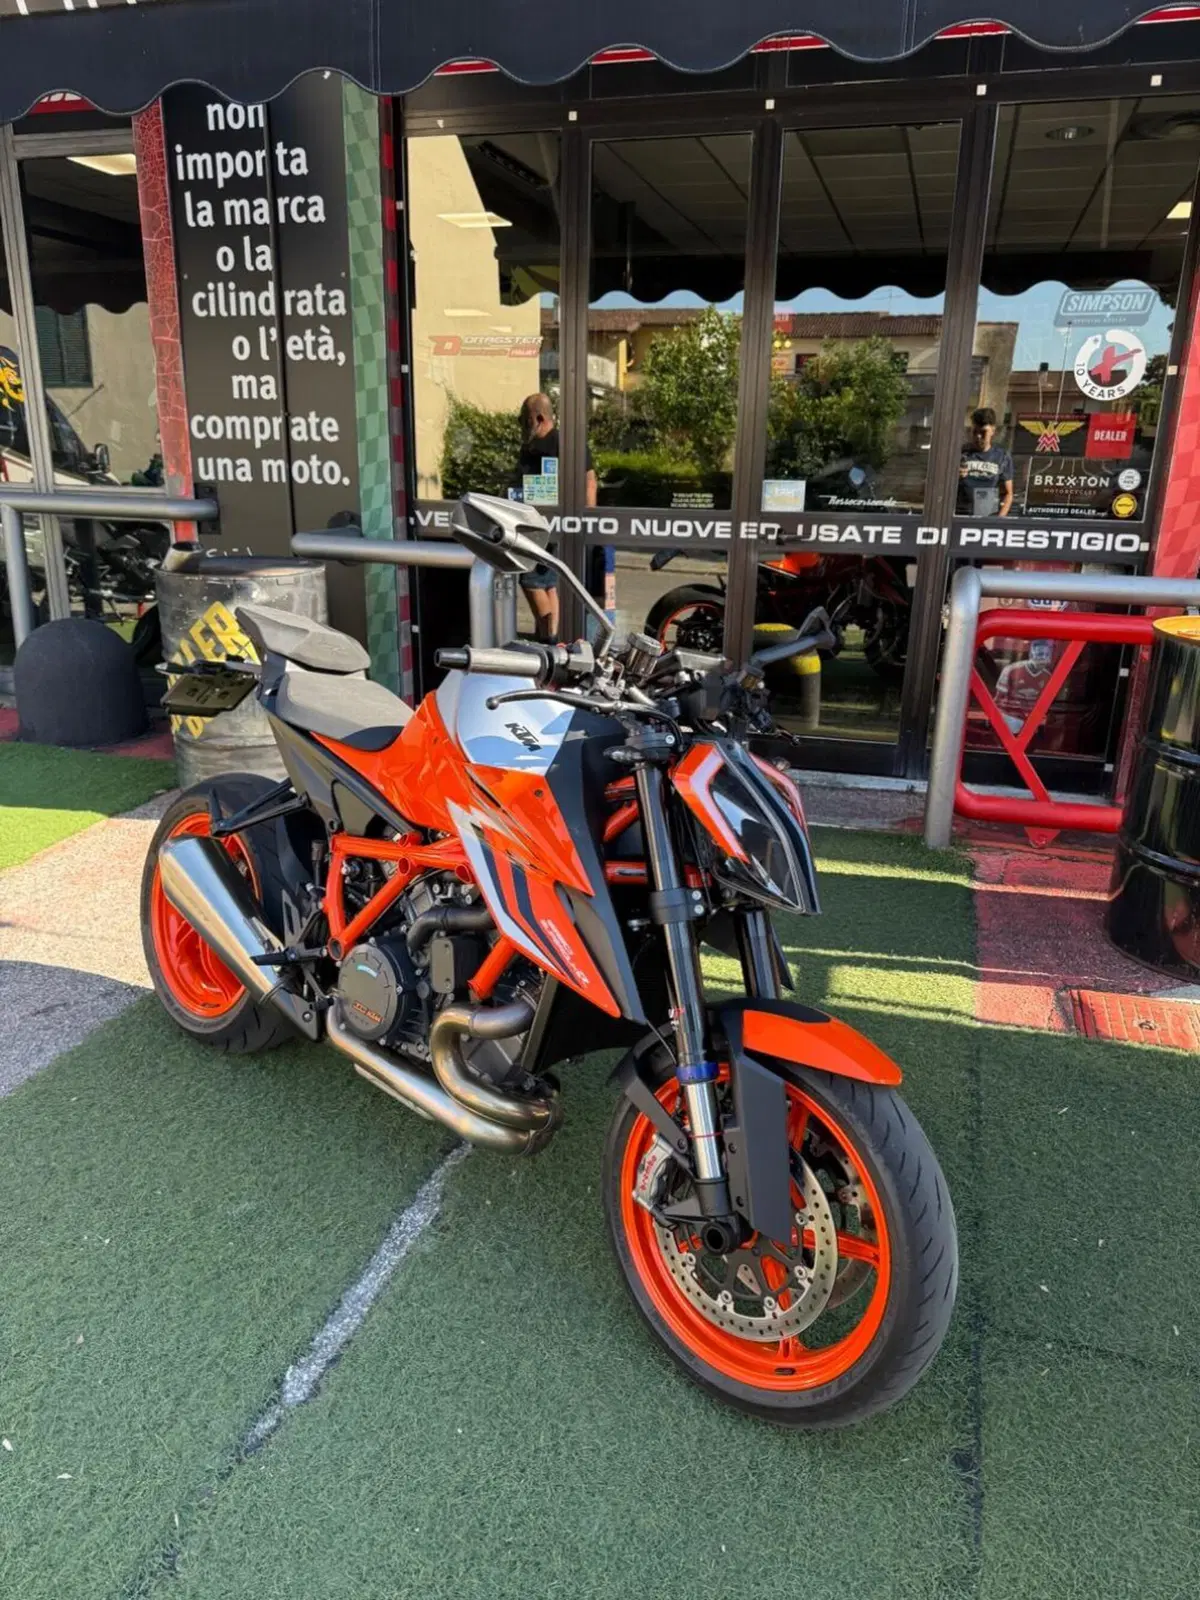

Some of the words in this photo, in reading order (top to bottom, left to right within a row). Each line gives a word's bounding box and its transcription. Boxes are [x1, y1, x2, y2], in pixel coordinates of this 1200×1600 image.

[206, 103, 265, 131] non
[175, 142, 308, 188] importa
[185, 191, 214, 227] la
[224, 194, 326, 226] marca
[216, 249, 235, 272] o
[243, 236, 272, 271] la
[192, 282, 347, 317] cilindrata
[1067, 293, 1144, 312] SIMPSON
[232, 336, 250, 361] o
[232, 375, 277, 400] ma
[1076, 363, 1085, 376] 10
[1082, 380, 1126, 398] YEARS
[191, 413, 339, 447] comprate
[1094, 430, 1127, 442] DEALER
[198, 457, 252, 483] una
[262, 455, 350, 486] moto.
[1034, 475, 1110, 487] BRIXTON
[1070, 508, 1097, 516] DEALER
[543, 516, 618, 535] MOTO
[630, 519, 732, 539] NUOVE
[797, 523, 902, 544] USATE
[916, 526, 948, 546] DI
[959, 527, 1150, 552] PRESTIGIO.
[505, 722, 542, 752] KTM
